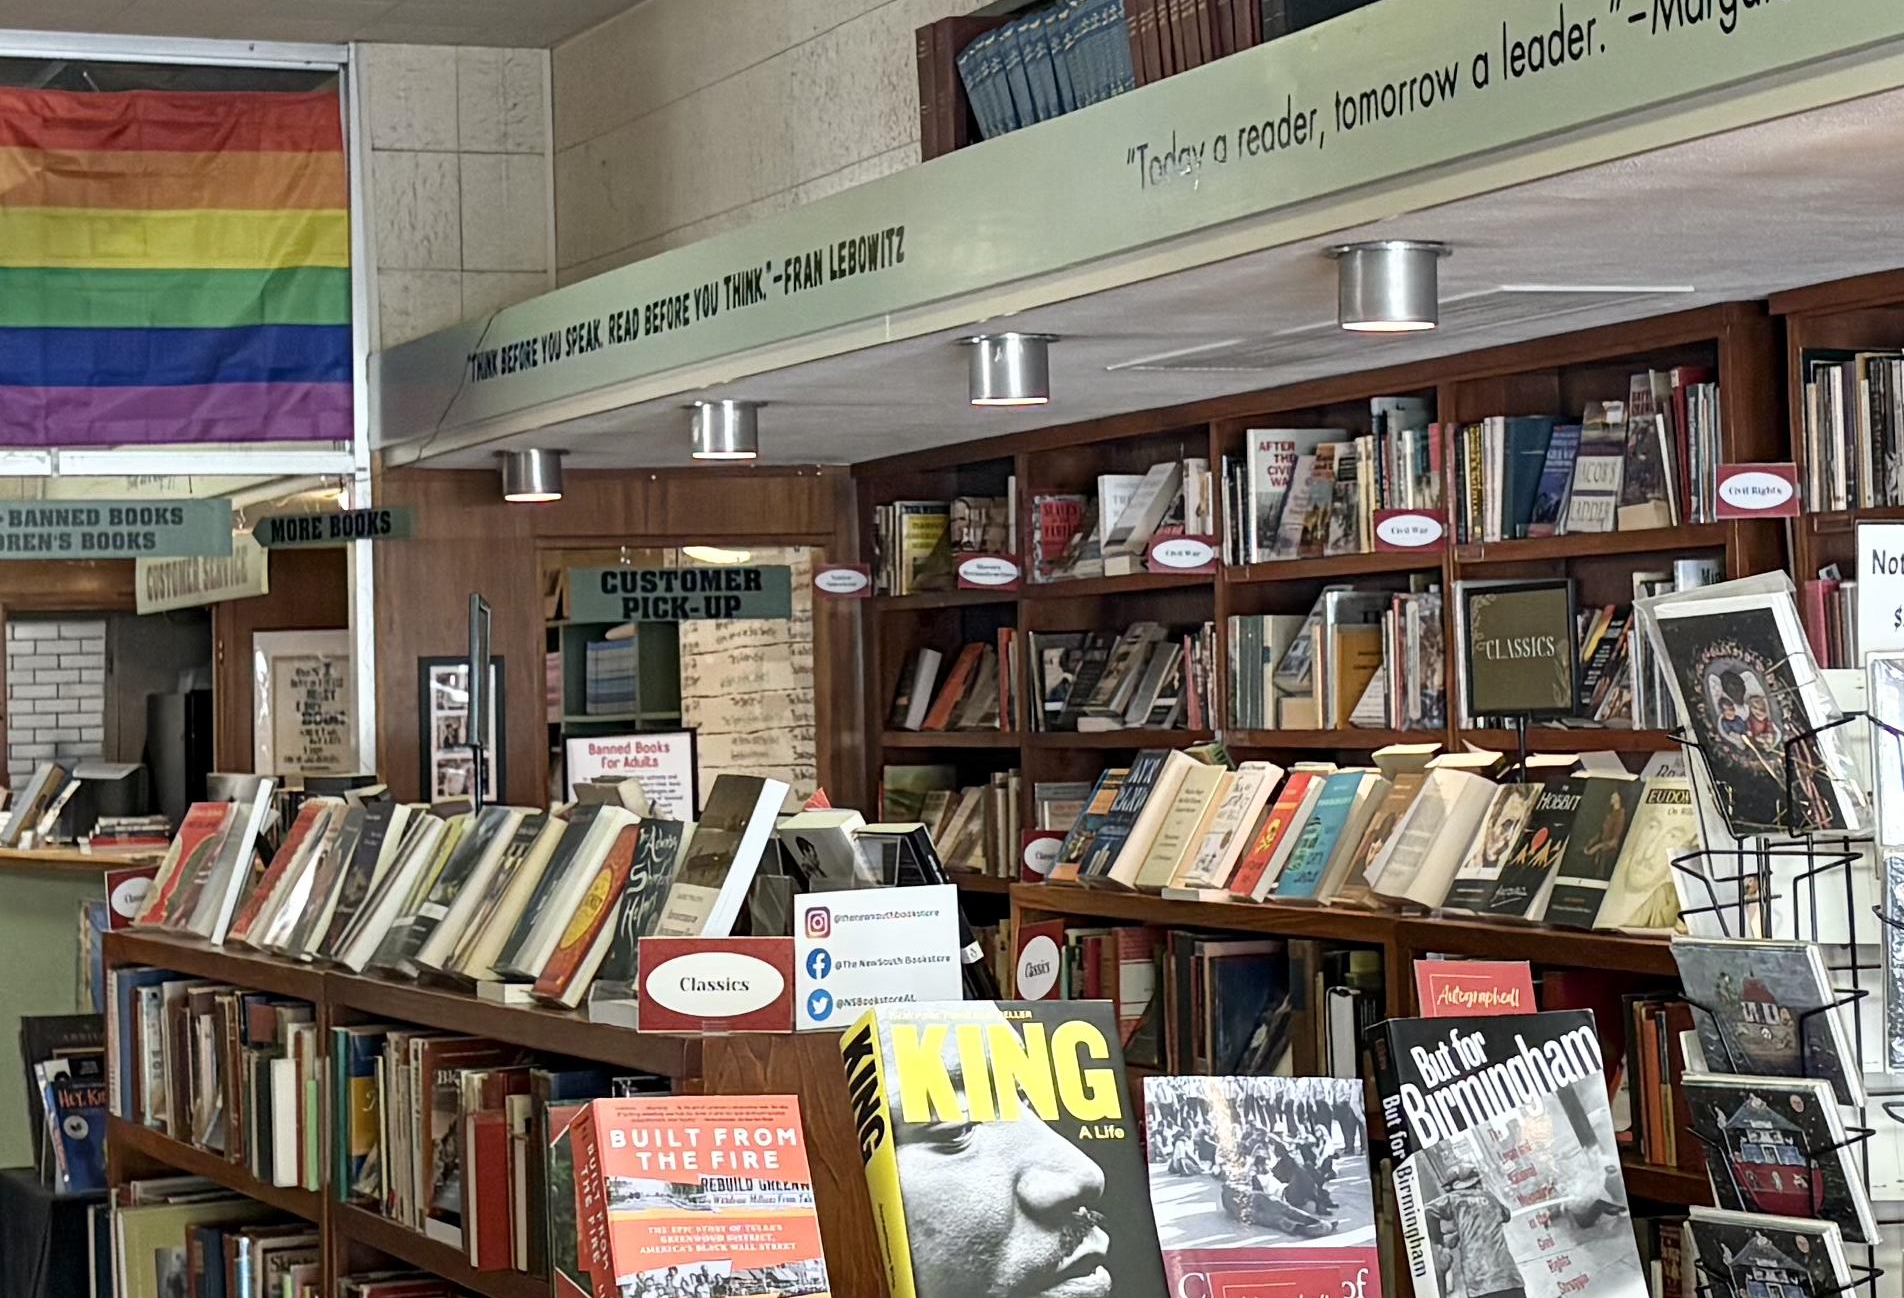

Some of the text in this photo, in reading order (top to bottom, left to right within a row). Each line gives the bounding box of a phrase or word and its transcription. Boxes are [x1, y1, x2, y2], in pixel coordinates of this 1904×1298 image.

[1213, 134, 1228, 164] a
[1237, 104, 1326, 160] reader,
[1334, 62, 1459, 132] tomorrow
[1472, 52, 1490, 89] a
[500, 338, 538, 375] BEFORE
[541, 332, 562, 362] YOU
[608, 313, 639, 345] READ
[644, 292, 691, 336] BEFORE
[694, 288, 718, 322] YOU
[829, 225, 906, 281] LEBOWITZ
[1728, 484, 1783, 498] Civil Rights
[8, 506, 101, 528] BANNED
[108, 505, 184, 526] BOOKS
[270, 510, 392, 543] MORE BOOKS
[81, 530, 158, 552] BOOKS
[600, 568, 763, 595] CUSTOMER
[621, 595, 742, 620] PICK-UP
[1486, 636, 1556, 661] CLASSICS
[588, 741, 671, 756] Banned Books
[623, 755, 659, 769] Adults
[1535, 792, 1583, 812] HOBBIT
[679, 976, 750, 993] Classics
[1437, 984, 1520, 1008] Autographed!
[1411, 1028, 1488, 1090] But for
[891, 1020, 1124, 1123] KING
[1399, 1024, 1604, 1152] Birmingham
[610, 1126, 797, 1149] BUILT FROM
[635, 1150, 780, 1171] THE FIRE
